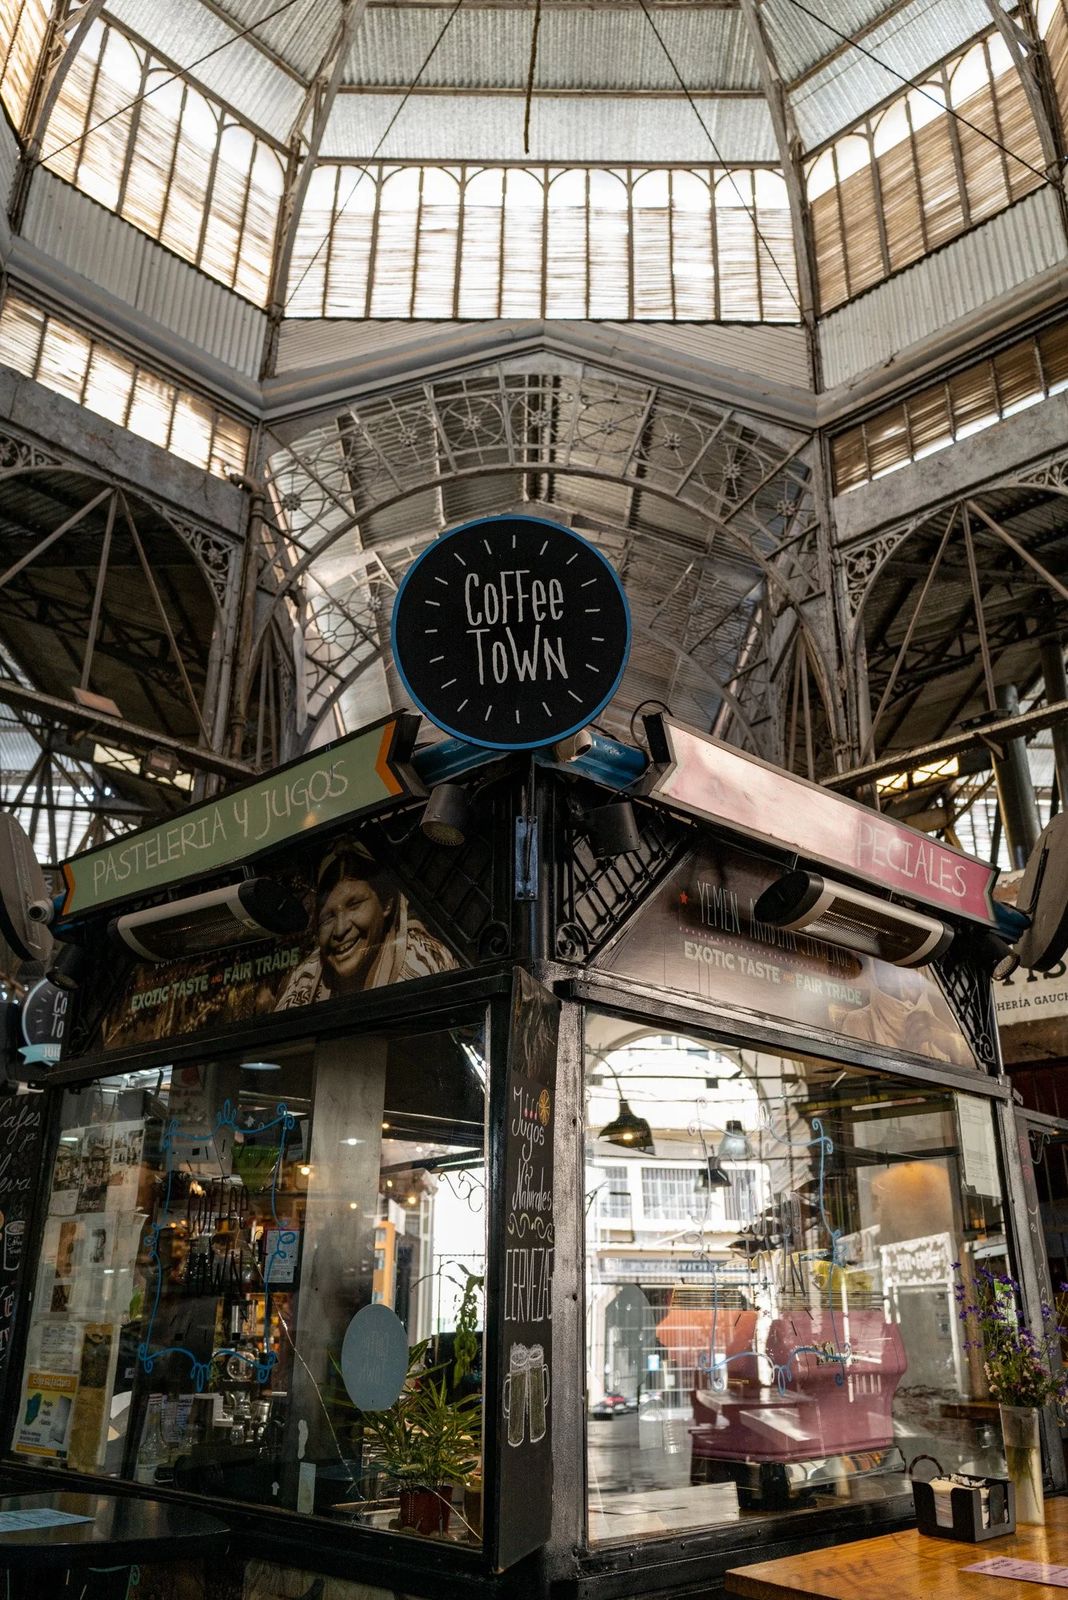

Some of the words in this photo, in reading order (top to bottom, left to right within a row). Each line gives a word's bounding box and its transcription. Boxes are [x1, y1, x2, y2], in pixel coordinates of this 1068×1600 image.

[94, 807, 227, 896] PASTELERIA
[255, 760, 348, 840] JUGOS
[855, 820, 967, 897] PECIALES
[696, 880, 741, 935] YEMEN
[131, 985, 169, 1010] EXOTIC
[170, 974, 210, 999] TASTE
[223, 960, 252, 985] FAIR
[255, 946, 302, 977] TRADE
[684, 940, 735, 971] EXOTIC
[738, 956, 780, 984] TASTE
[795, 973, 825, 995] FAIR
[825, 980, 863, 1006] TRADE
[995, 994, 1031, 1011] HERÍA
[512, 1086, 546, 1162] Jugos
[512, 1158, 553, 1211] Naturales
